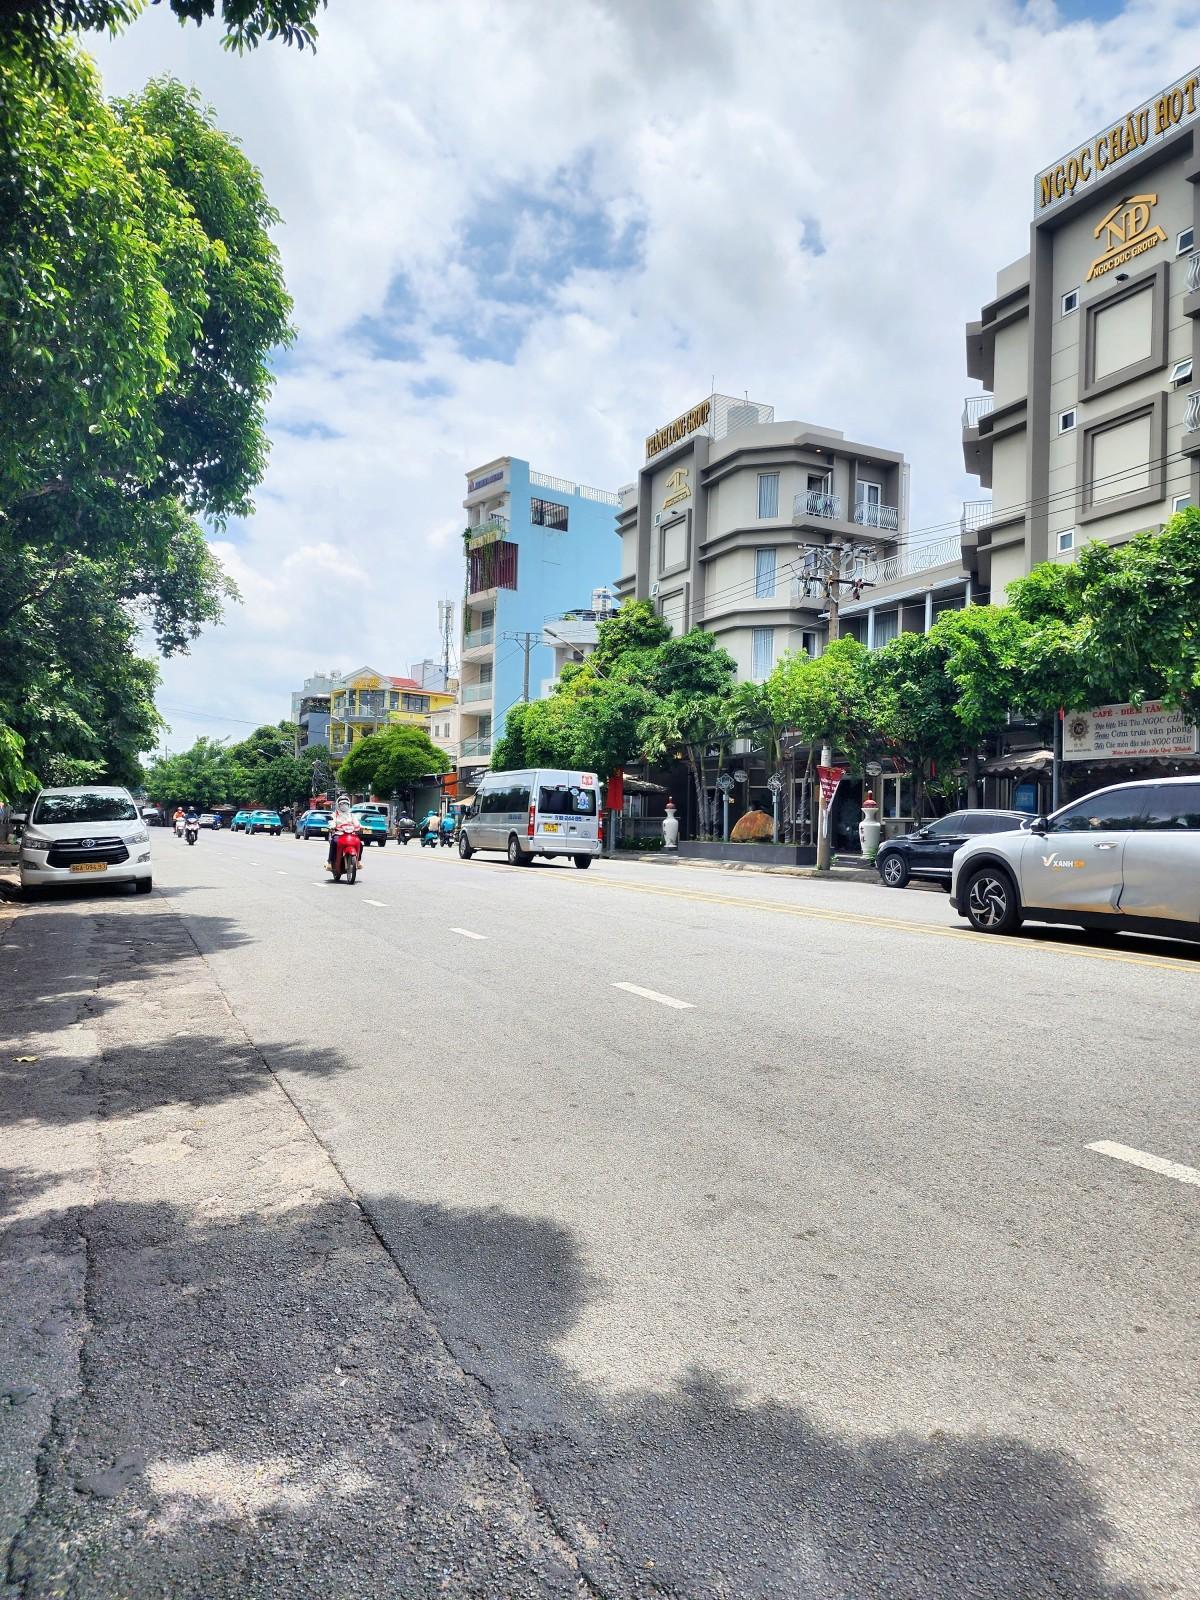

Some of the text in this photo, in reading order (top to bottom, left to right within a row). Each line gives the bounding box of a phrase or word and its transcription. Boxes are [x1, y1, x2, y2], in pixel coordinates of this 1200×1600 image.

[1040, 147, 1091, 207] NGỌC
[1094, 109, 1149, 171] CHÂU
[1131, 235, 1159, 257] GROUP
[687, 400, 710, 433] GROUP
[1053, 860, 1073, 868] XANH
